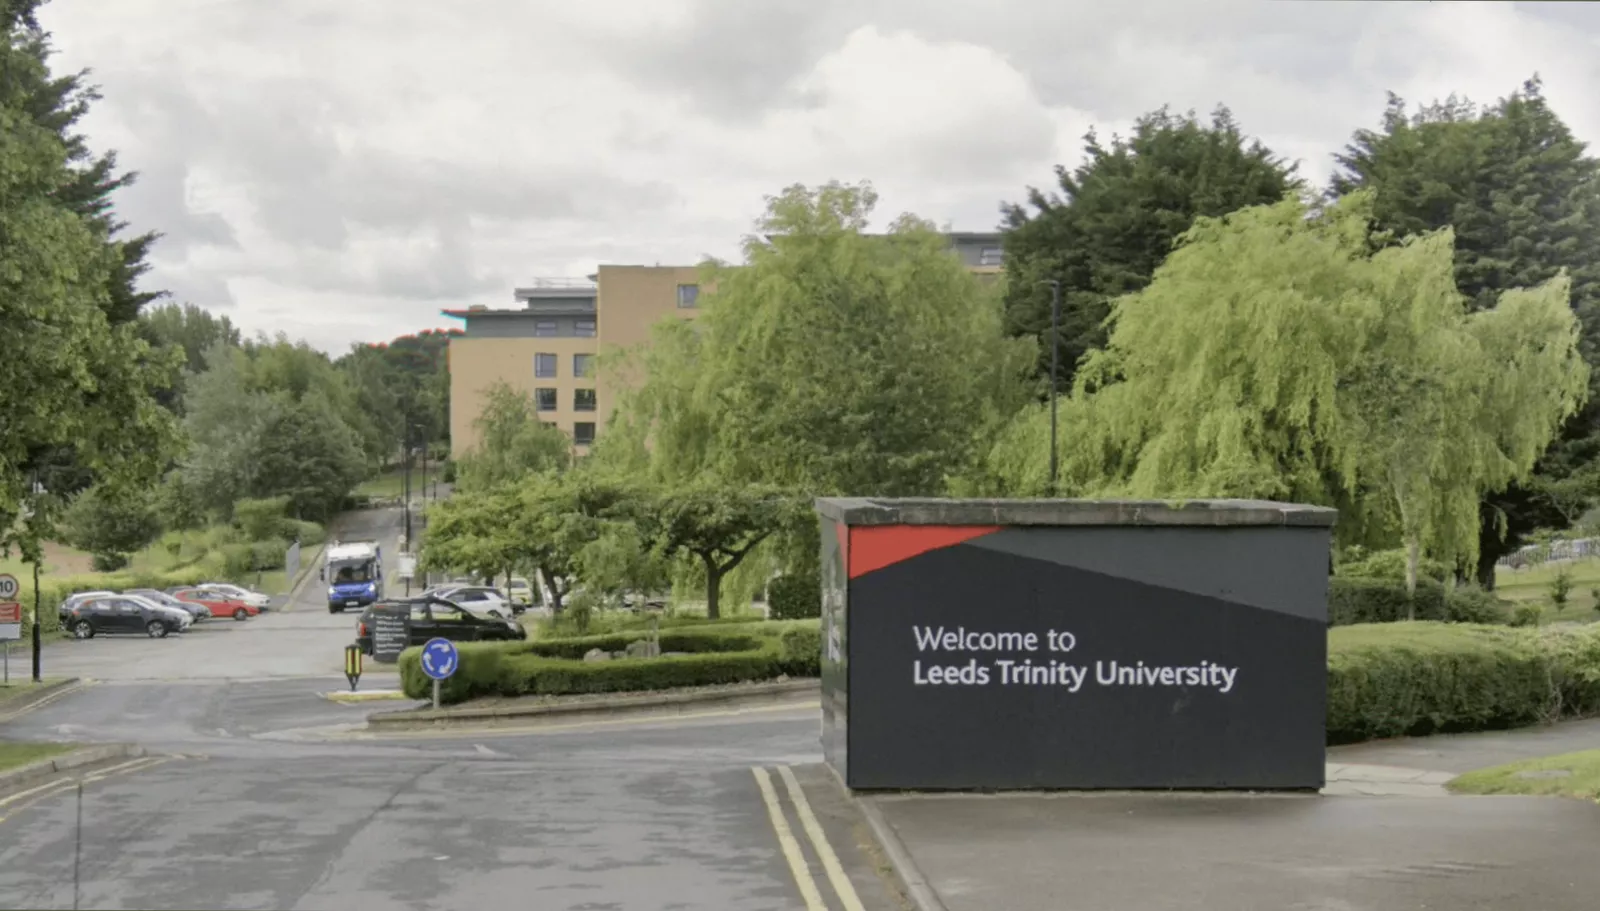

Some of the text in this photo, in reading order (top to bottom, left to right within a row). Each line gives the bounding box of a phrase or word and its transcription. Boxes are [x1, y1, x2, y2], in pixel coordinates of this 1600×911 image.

[0, 580, 13, 593] 10
[912, 625, 1076, 652] Welcome to
[913, 658, 1239, 693] Leeds Trinity University
